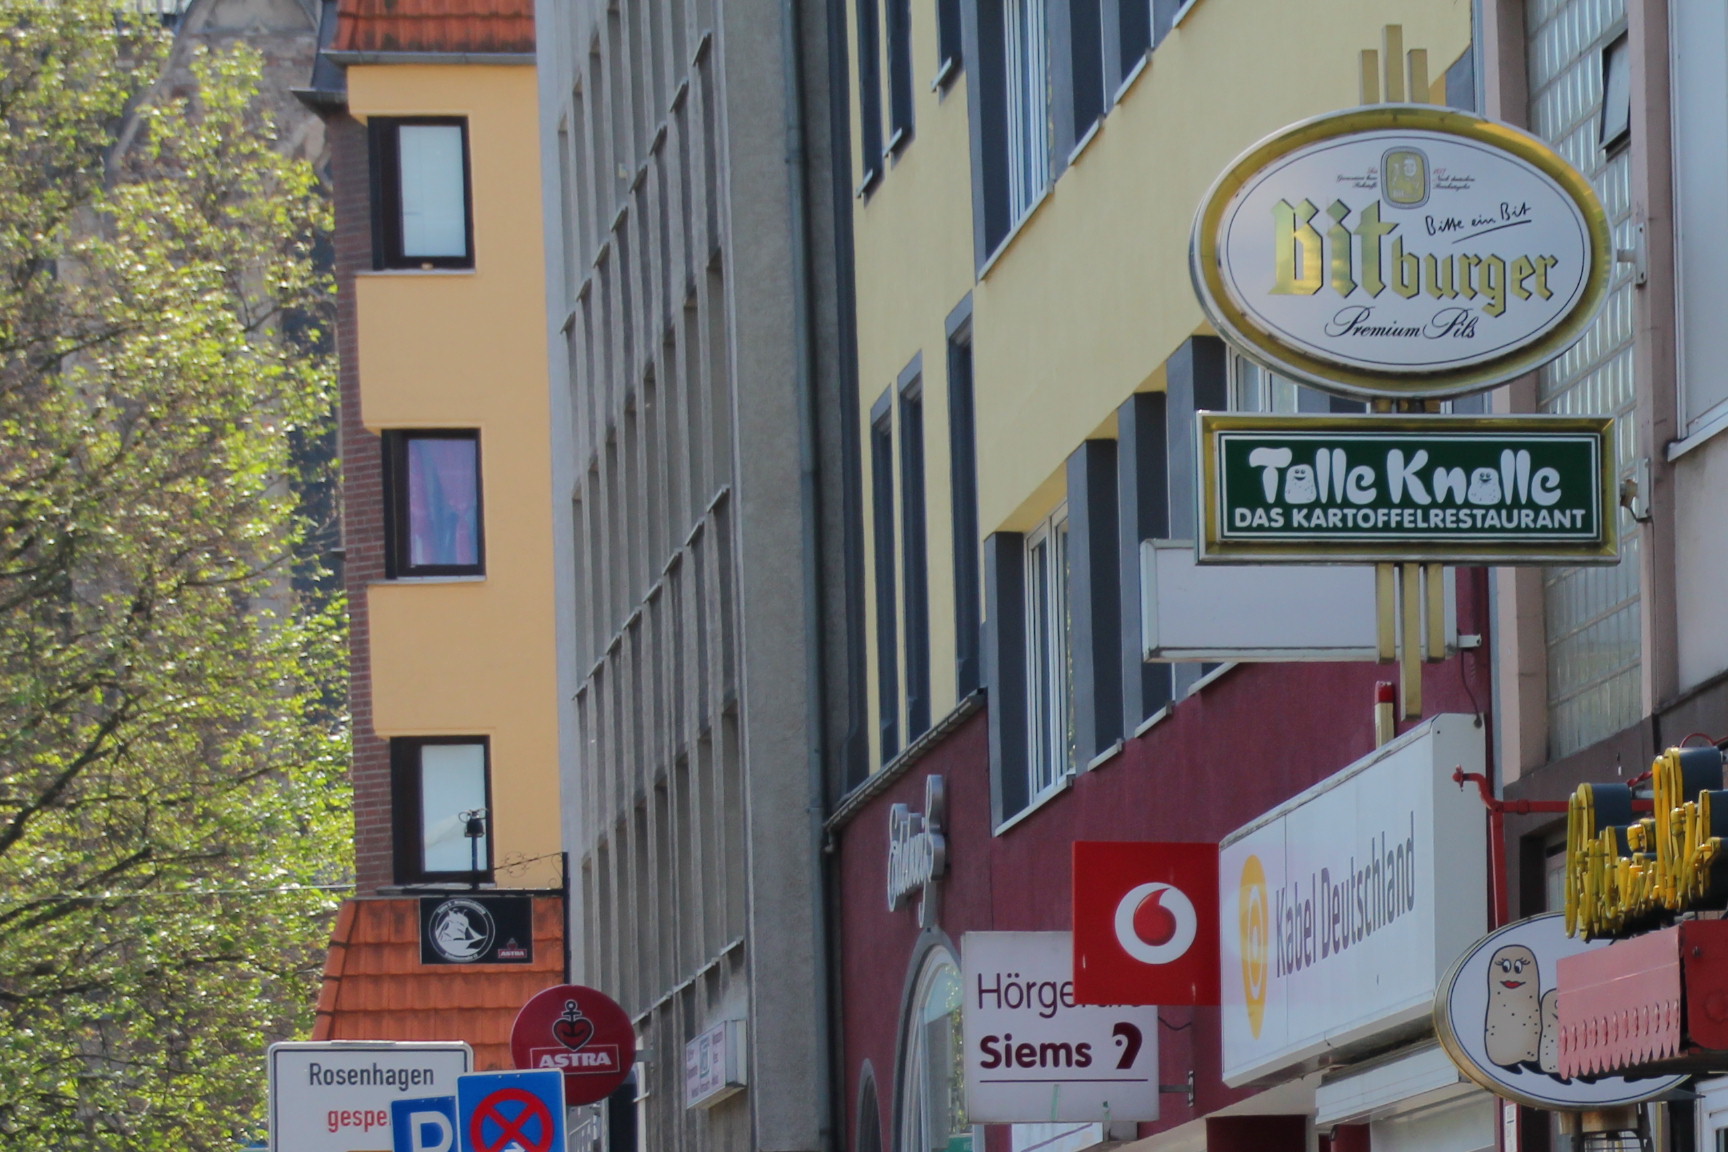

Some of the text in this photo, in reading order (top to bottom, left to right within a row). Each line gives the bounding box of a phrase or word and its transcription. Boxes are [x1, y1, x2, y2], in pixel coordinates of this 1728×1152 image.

[1425, 202, 1532, 236] Bitte ein Bit
[1267, 197, 1558, 318] Bitburger
[1324, 305, 1480, 339] Premium Pils
[1234, 506, 1586, 530] DAS KARTOFFELRESTAURANT
[1275, 872, 1317, 978] Kabel
[1321, 811, 1416, 961] Deutschland
[977, 972, 1142, 1019] Hörge
[539, 1052, 612, 1069] ASTRA
[979, 1032, 1093, 1069] Siems
[308, 1062, 434, 1092] Rosenhagen
[327, 1109, 391, 1133] gespe
